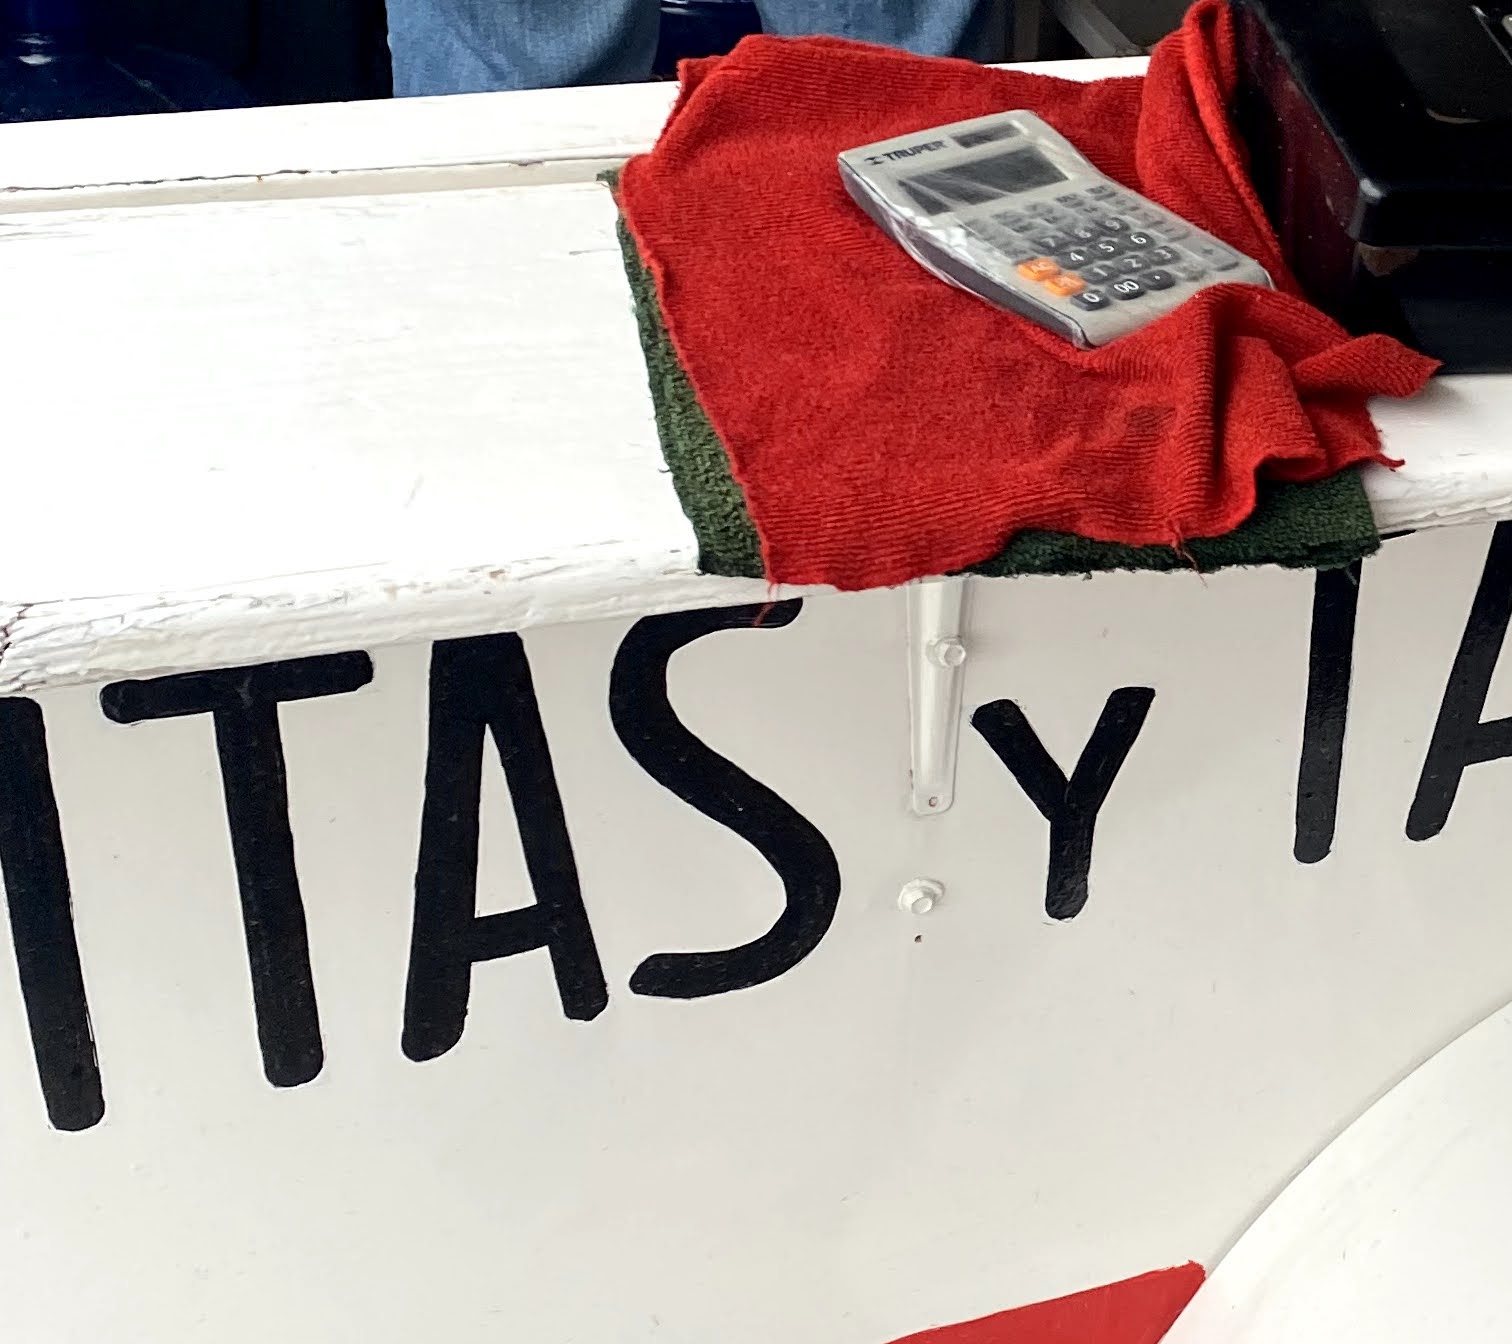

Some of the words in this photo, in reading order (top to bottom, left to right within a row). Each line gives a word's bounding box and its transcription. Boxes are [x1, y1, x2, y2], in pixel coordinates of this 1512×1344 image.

[881, 140, 948, 161] TRUPER
[1130, 231, 1147, 244] 6
[970, 686, 1156, 921] Y
